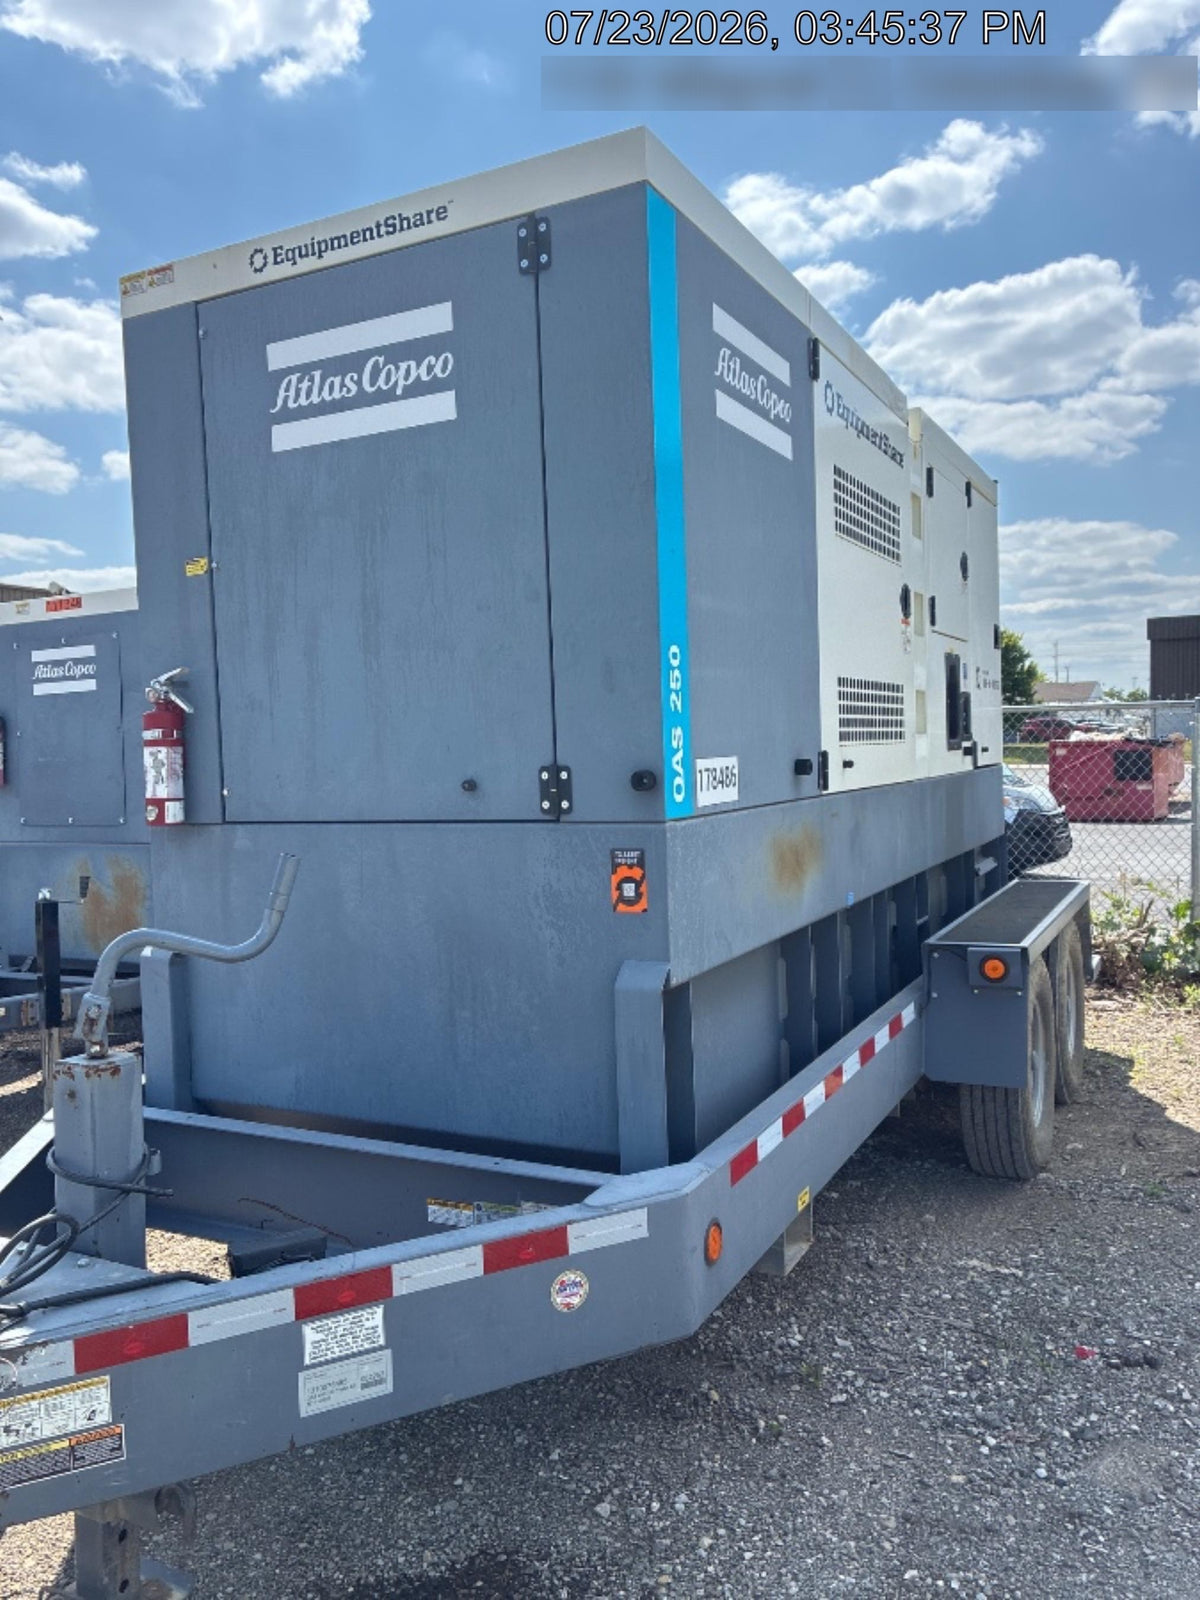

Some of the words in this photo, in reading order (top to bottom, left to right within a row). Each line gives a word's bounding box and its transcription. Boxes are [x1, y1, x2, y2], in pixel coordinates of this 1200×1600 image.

[272, 203, 449, 266] EquipmentShare
[270, 369, 358, 413] Atlas
[362, 352, 454, 395] Copco
[714, 347, 758, 400] Atlas
[757, 375, 793, 423] Copco
[33, 664, 65, 680] Atlas
[65, 660, 97, 678] Copco
[668, 644, 682, 713] 250
[698, 764, 737, 792] 178486
